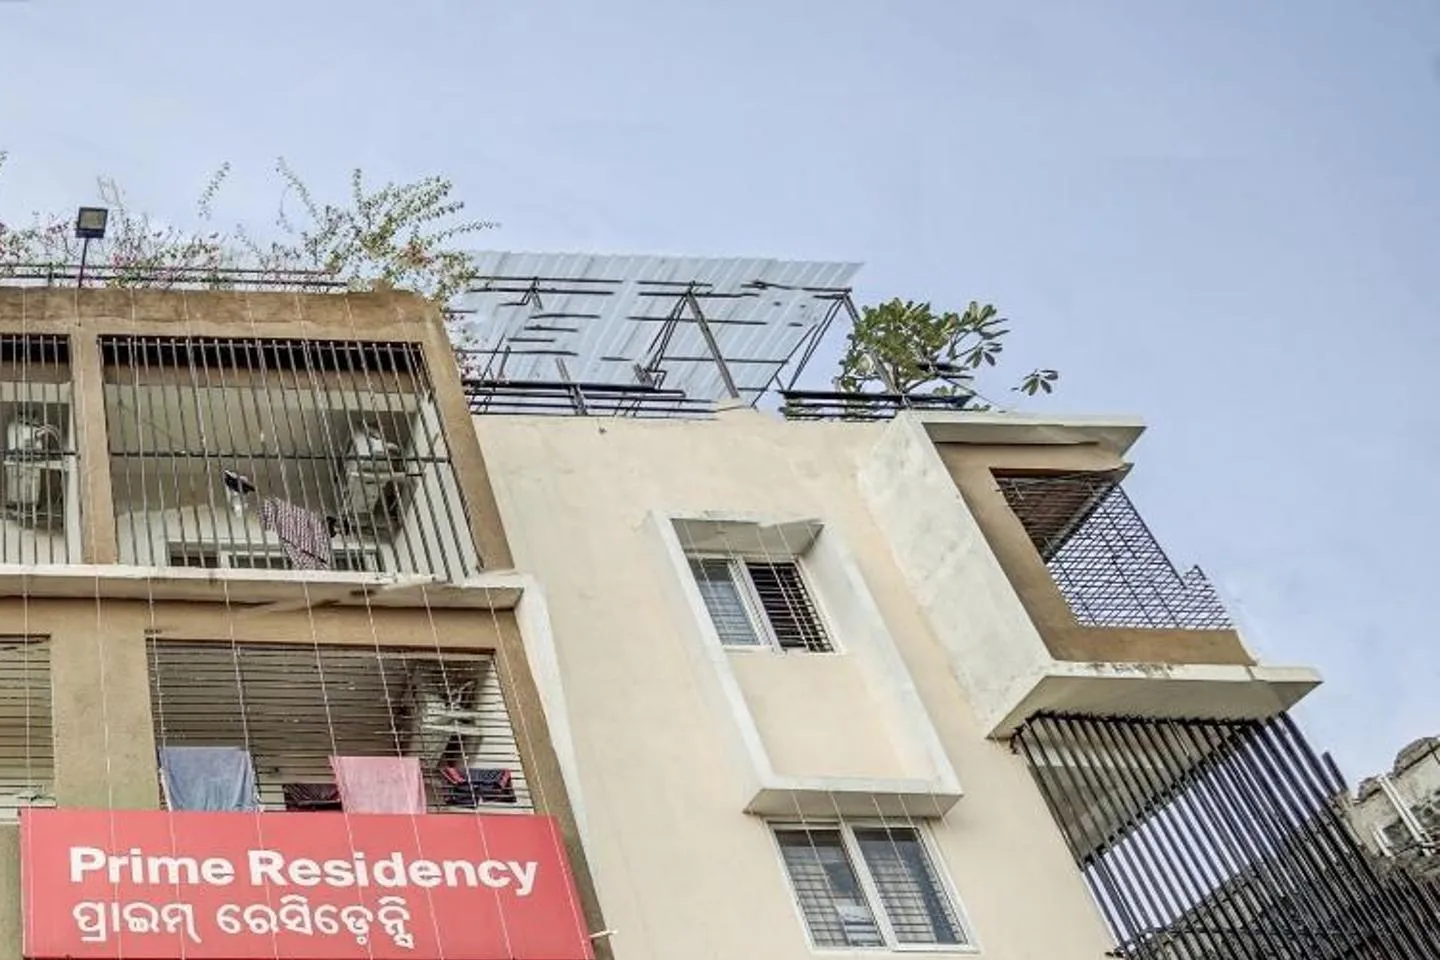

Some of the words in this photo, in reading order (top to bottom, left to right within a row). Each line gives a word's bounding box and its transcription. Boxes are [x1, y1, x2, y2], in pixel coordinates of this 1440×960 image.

[70, 846, 235, 885] Prime
[247, 850, 537, 896] Residency
[72, 902, 201, 943] ପ୍ରାଇମ୍
